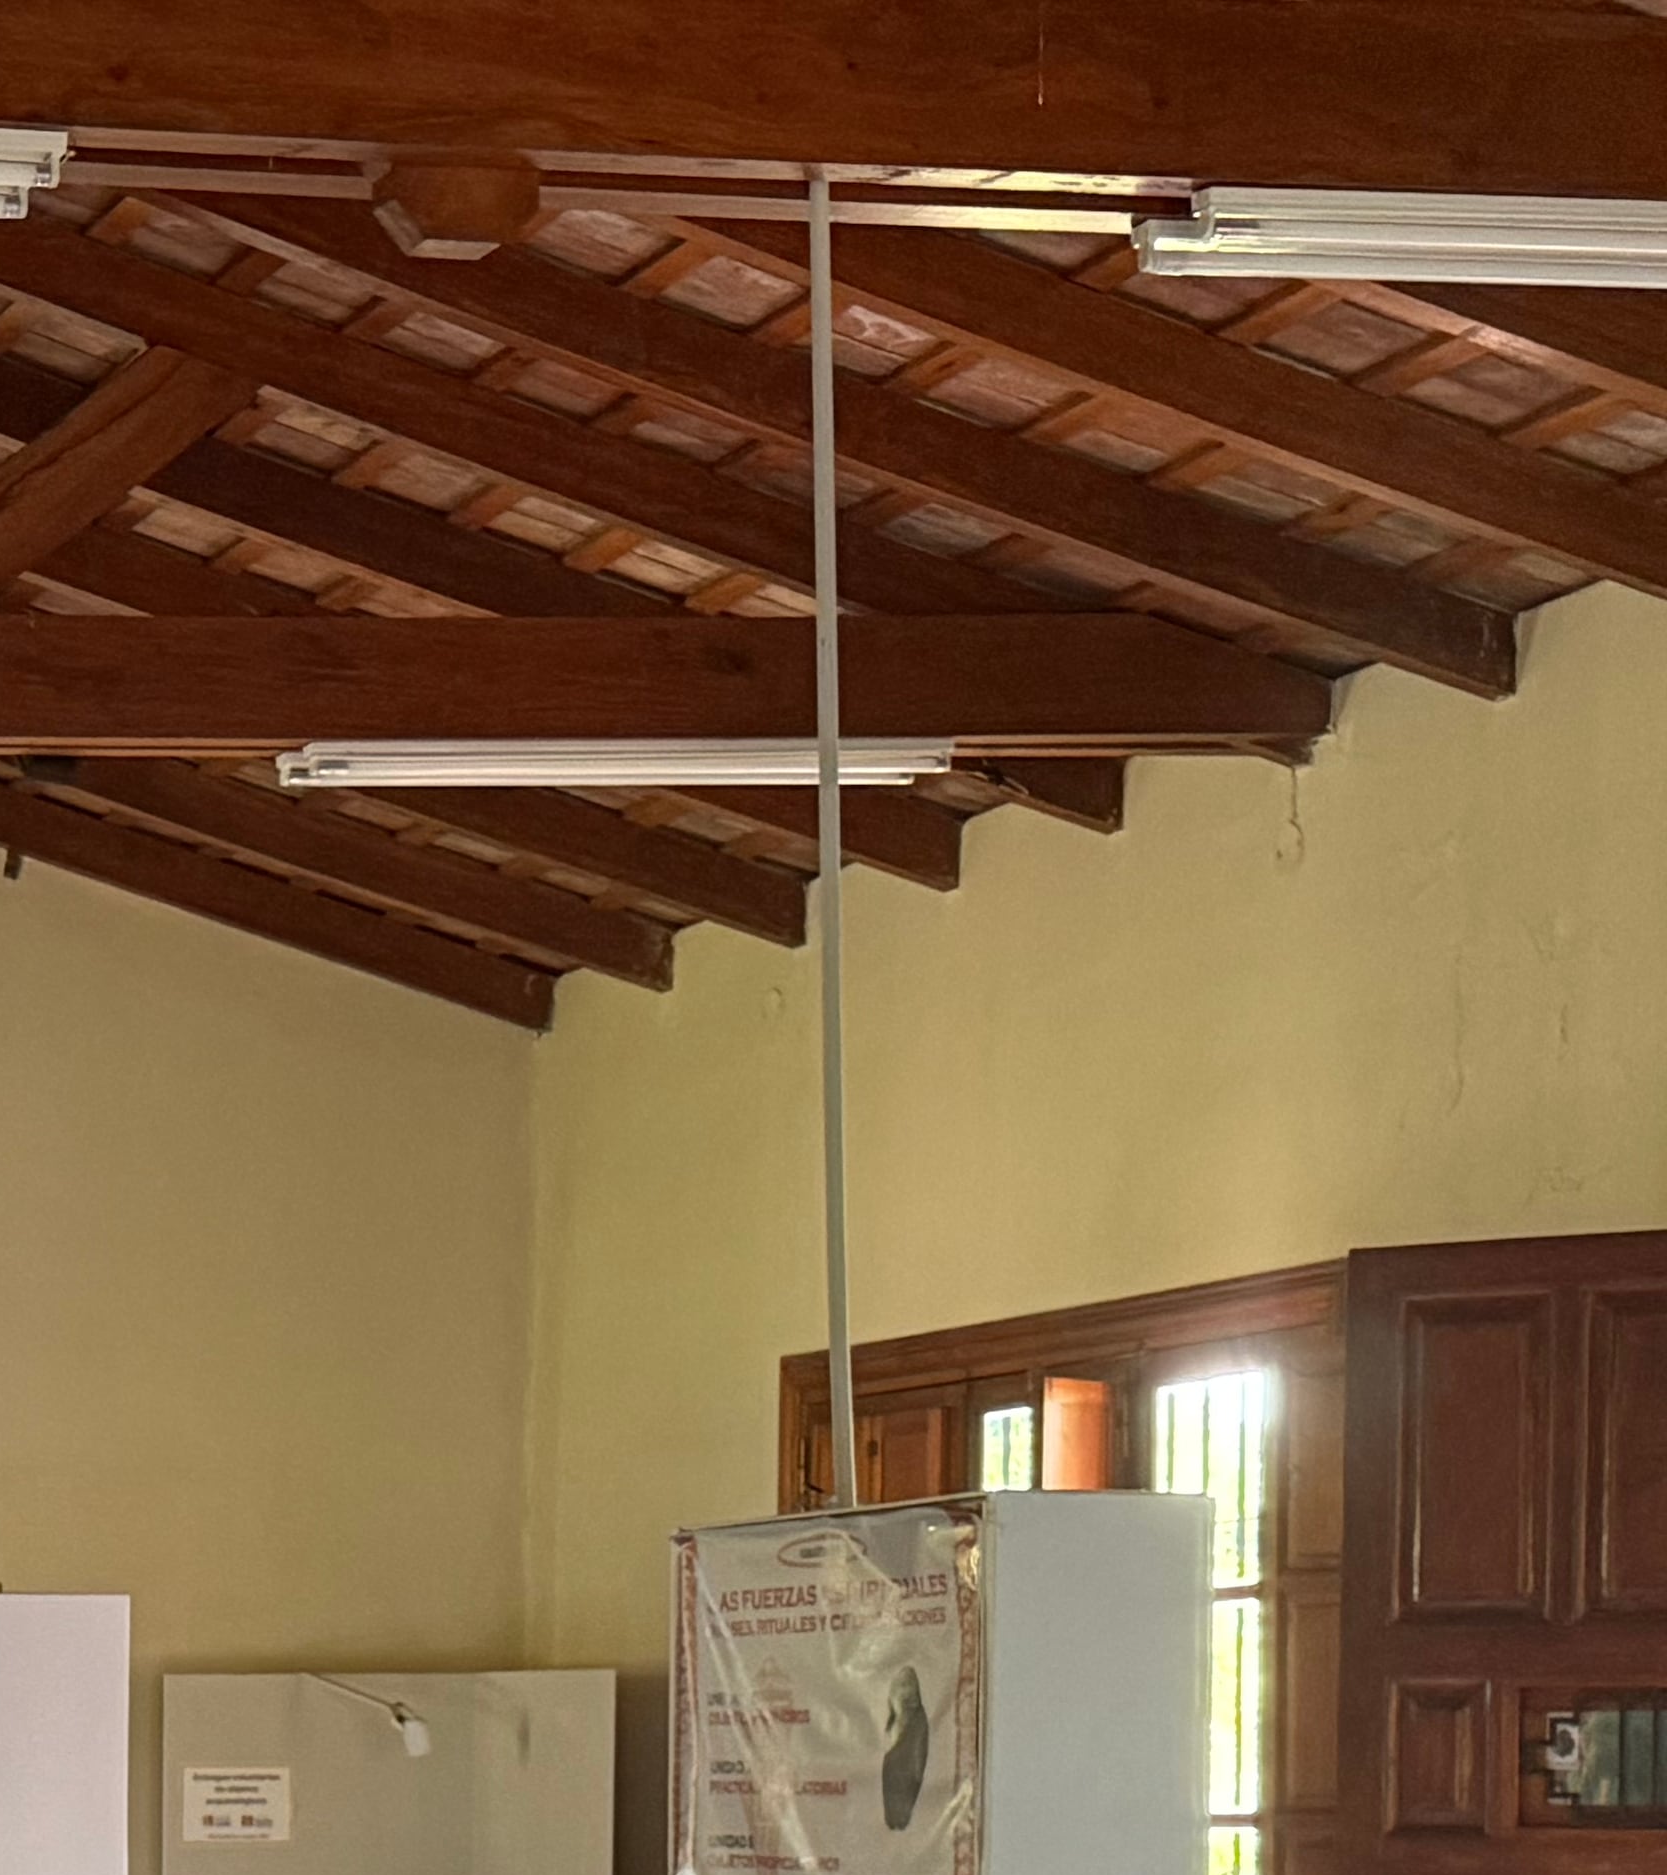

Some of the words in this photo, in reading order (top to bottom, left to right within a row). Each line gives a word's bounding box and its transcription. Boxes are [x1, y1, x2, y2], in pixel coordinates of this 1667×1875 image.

[742, 1584, 817, 1609] FUERZAS
[758, 1614, 816, 1634] RITUALES
[819, 1614, 826, 1632] Y
